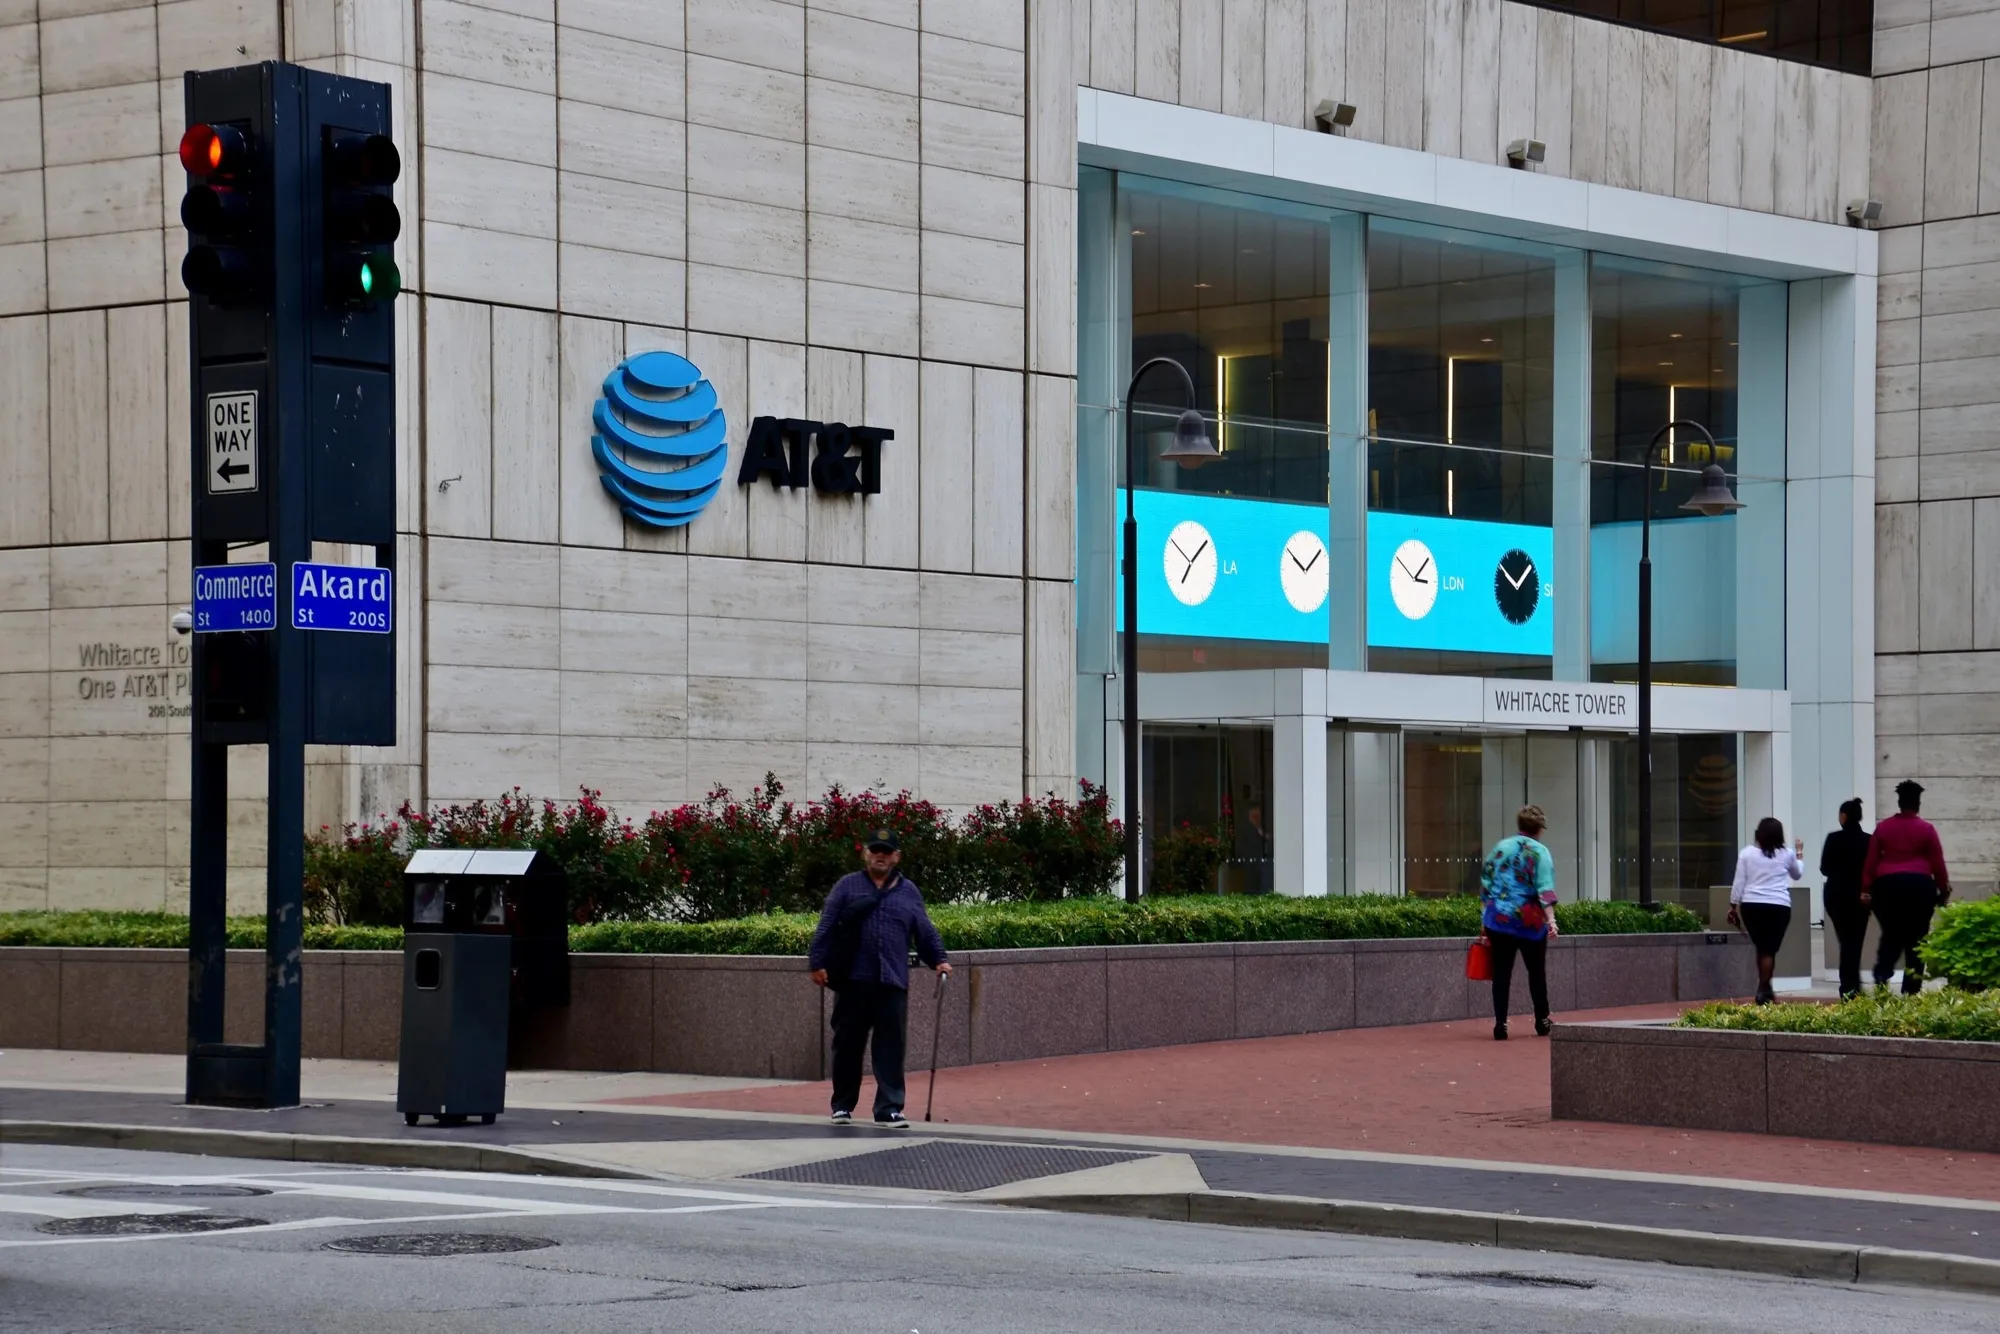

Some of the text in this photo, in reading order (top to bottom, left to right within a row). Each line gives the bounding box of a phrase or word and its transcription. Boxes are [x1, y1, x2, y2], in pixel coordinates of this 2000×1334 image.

[214, 401, 251, 426] ONE
[214, 428, 251, 453] WAY
[737, 415, 895, 495] AT&T
[1223, 560, 1238, 575] LA
[195, 574, 273, 601] Commerce
[299, 569, 386, 602] Akard
[1442, 577, 1464, 591] LDN
[1543, 583, 1553, 597] S
[198, 609, 271, 626] St 1400
[298, 608, 386, 627] St 200S
[79, 641, 192, 667] Whitacre To
[79, 677, 116, 700] One
[122, 673, 168, 698] AT&T
[1495, 690, 1626, 716] WHITACRE TOWER
